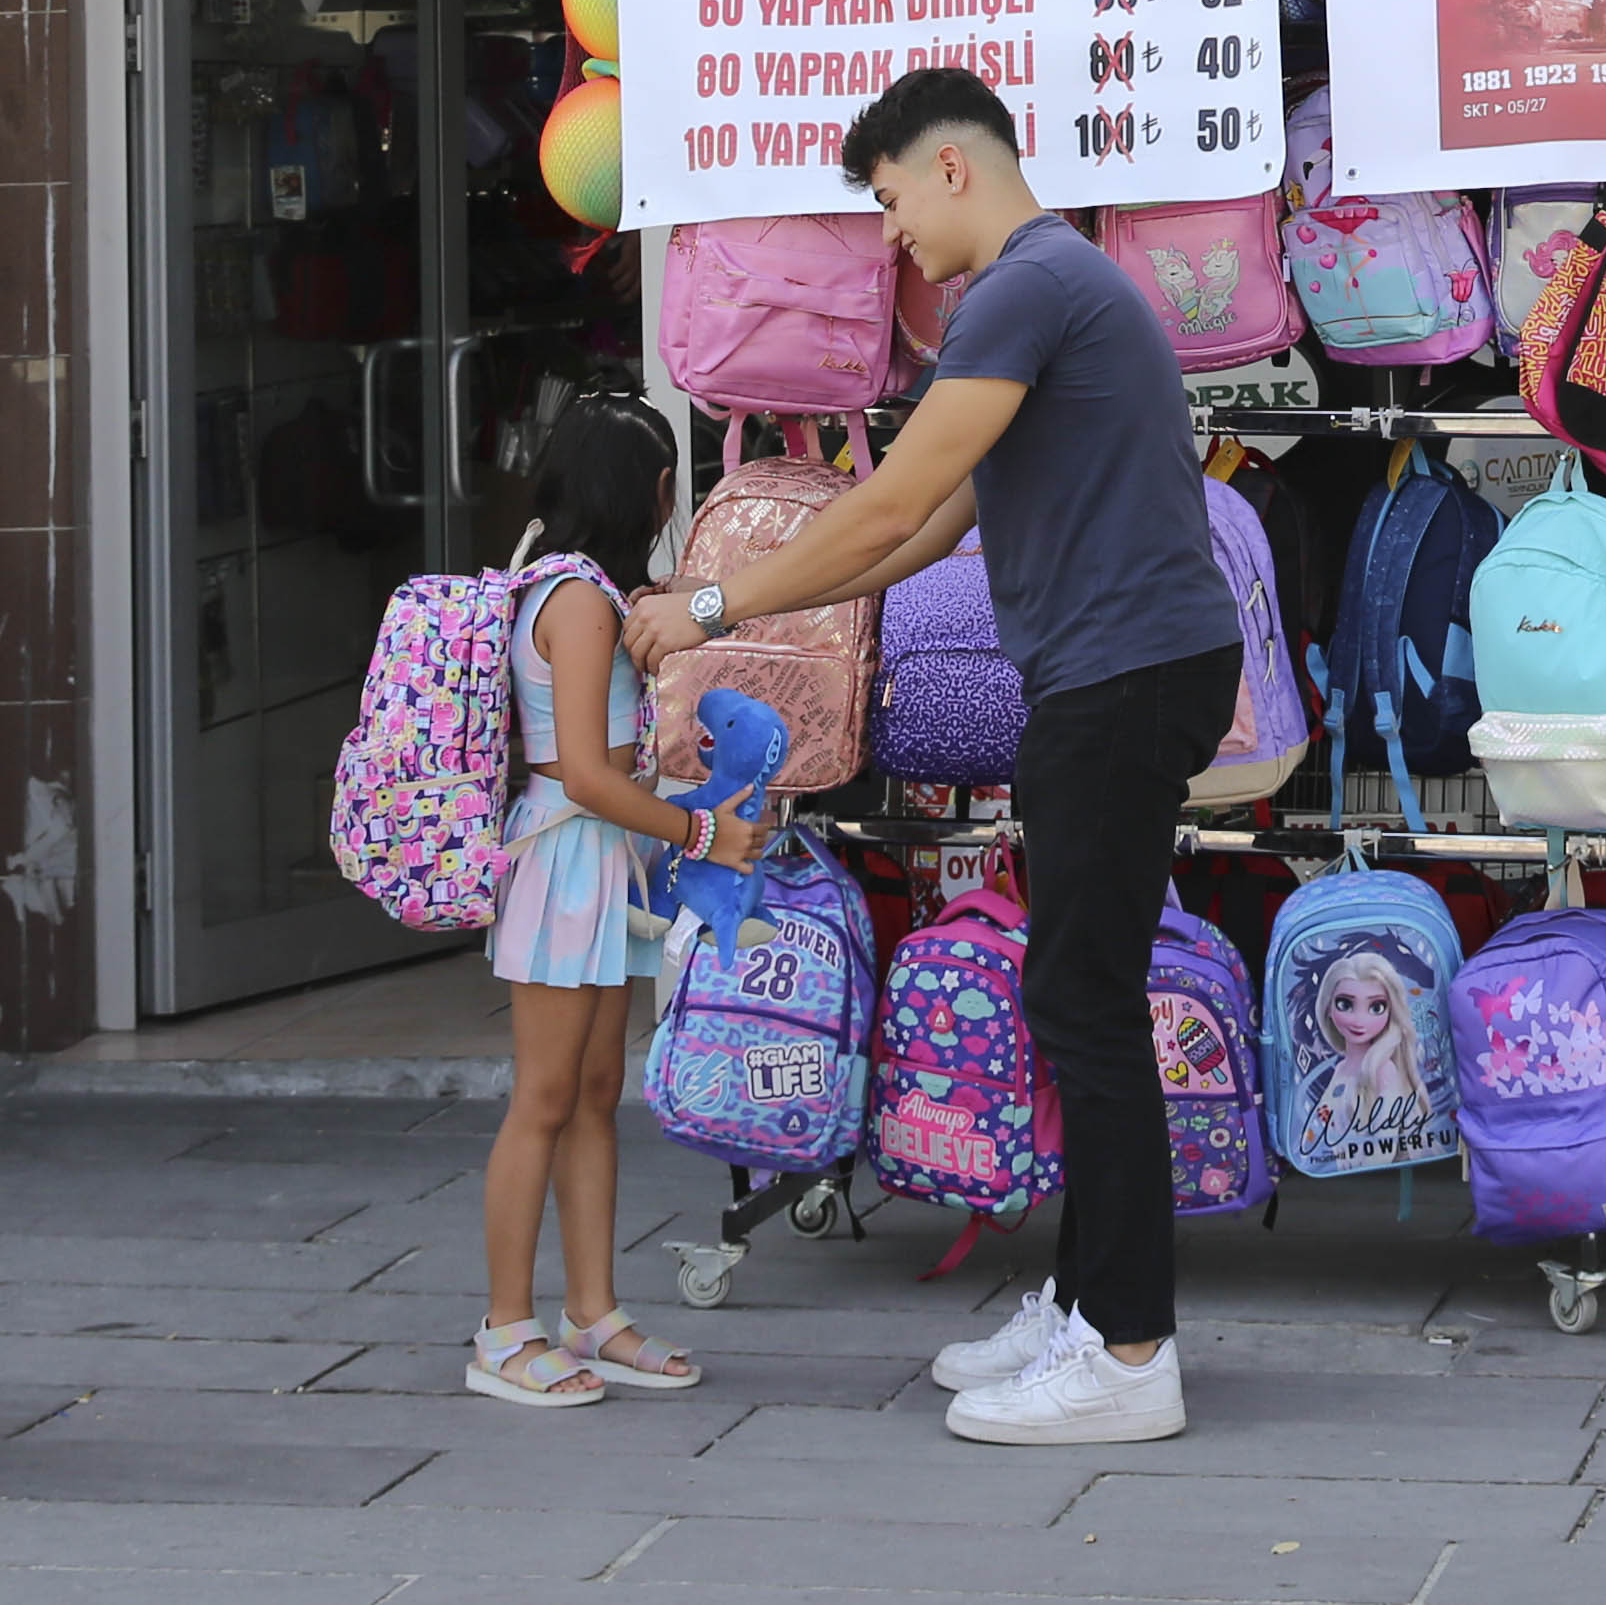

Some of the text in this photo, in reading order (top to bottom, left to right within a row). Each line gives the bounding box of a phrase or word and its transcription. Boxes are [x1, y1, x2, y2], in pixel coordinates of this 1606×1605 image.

[697, 54, 741, 97] 80
[755, 49, 891, 96] YAPRAK
[1462, 69, 1511, 93] 1881
[1523, 65, 1577, 87] 1923
[1463, 97, 1547, 119] SKT 05/27
[684, 123, 737, 171] 100
[751, 122, 842, 166] YAPR
[1178, 312, 1236, 336] Magic
[742, 947, 798, 1001] 28
[748, 1045, 820, 1068] #GLAM
[752, 1063, 822, 1099] LIFE
[903, 1094, 970, 1135] Always
[1300, 1090, 1436, 1156] Wildly
[884, 1115, 991, 1175] BELIEVE
